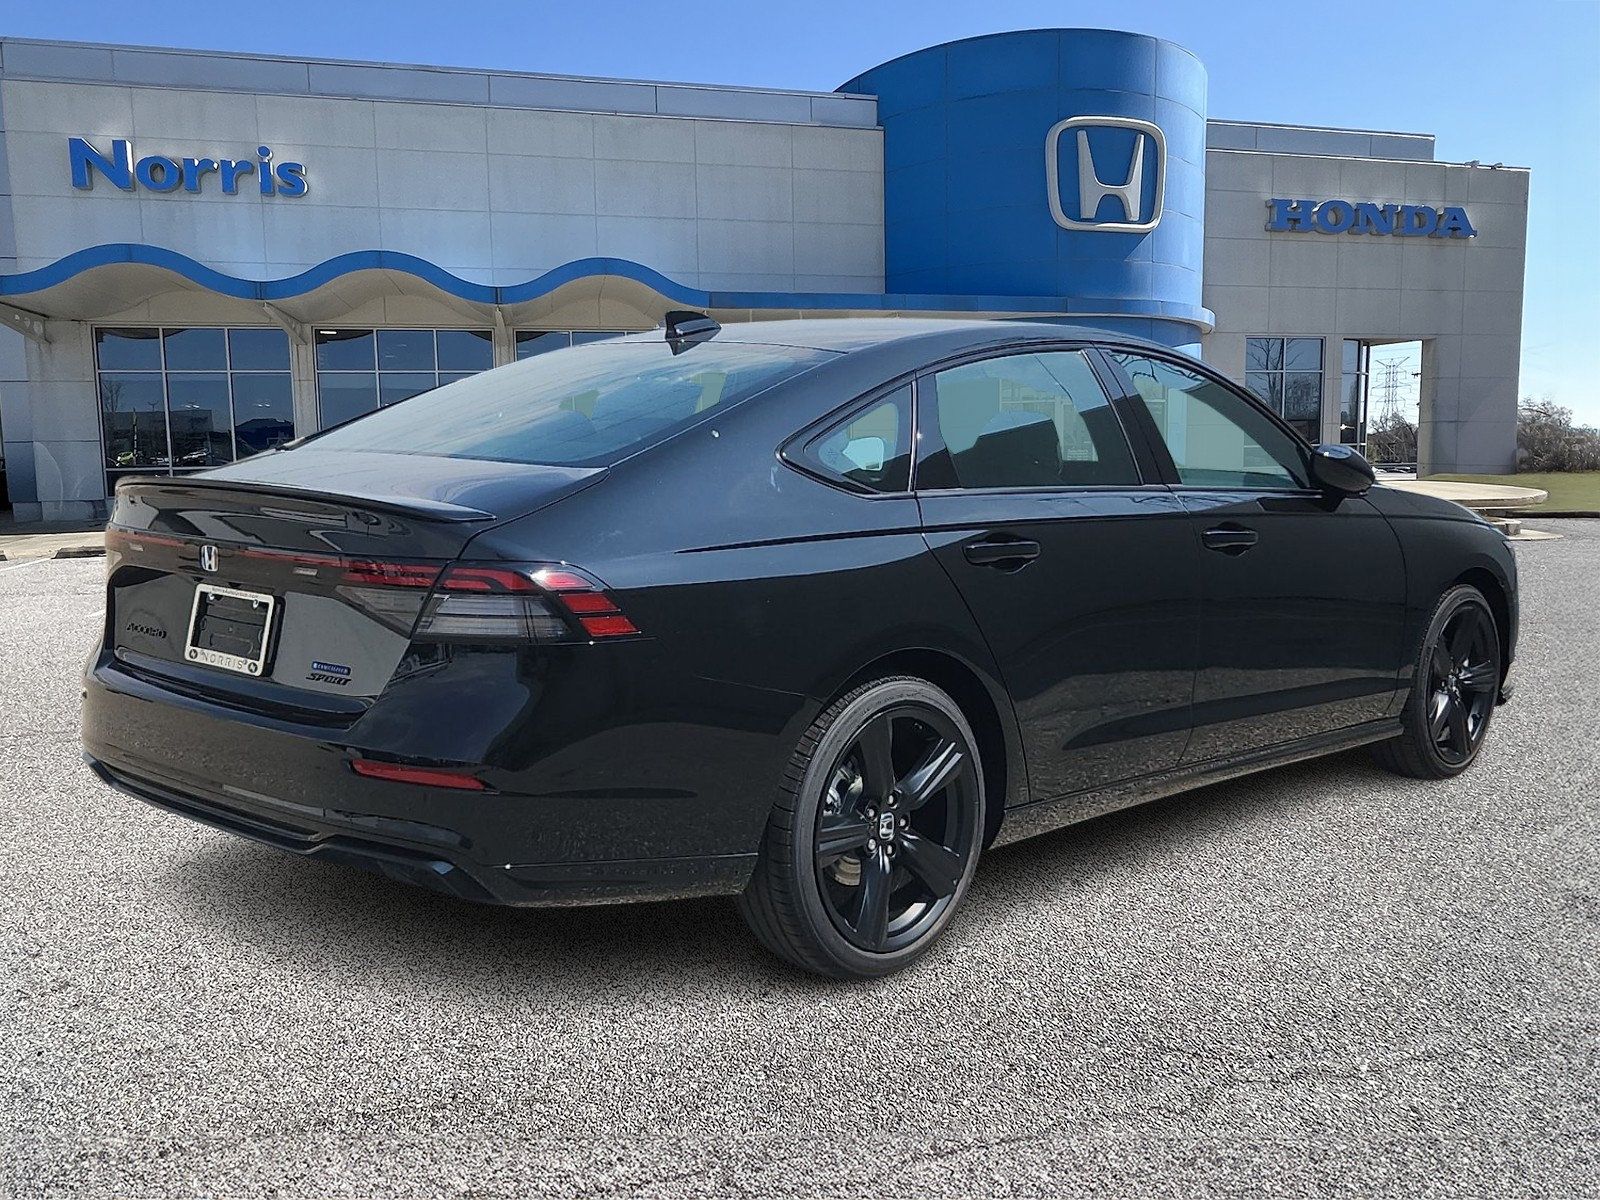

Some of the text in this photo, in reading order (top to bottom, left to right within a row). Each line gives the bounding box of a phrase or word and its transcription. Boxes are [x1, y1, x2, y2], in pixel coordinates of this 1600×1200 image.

[68, 137, 309, 197] Norris
[1266, 198, 1477, 239] HONDA
[305, 672, 352, 686] SPORT
